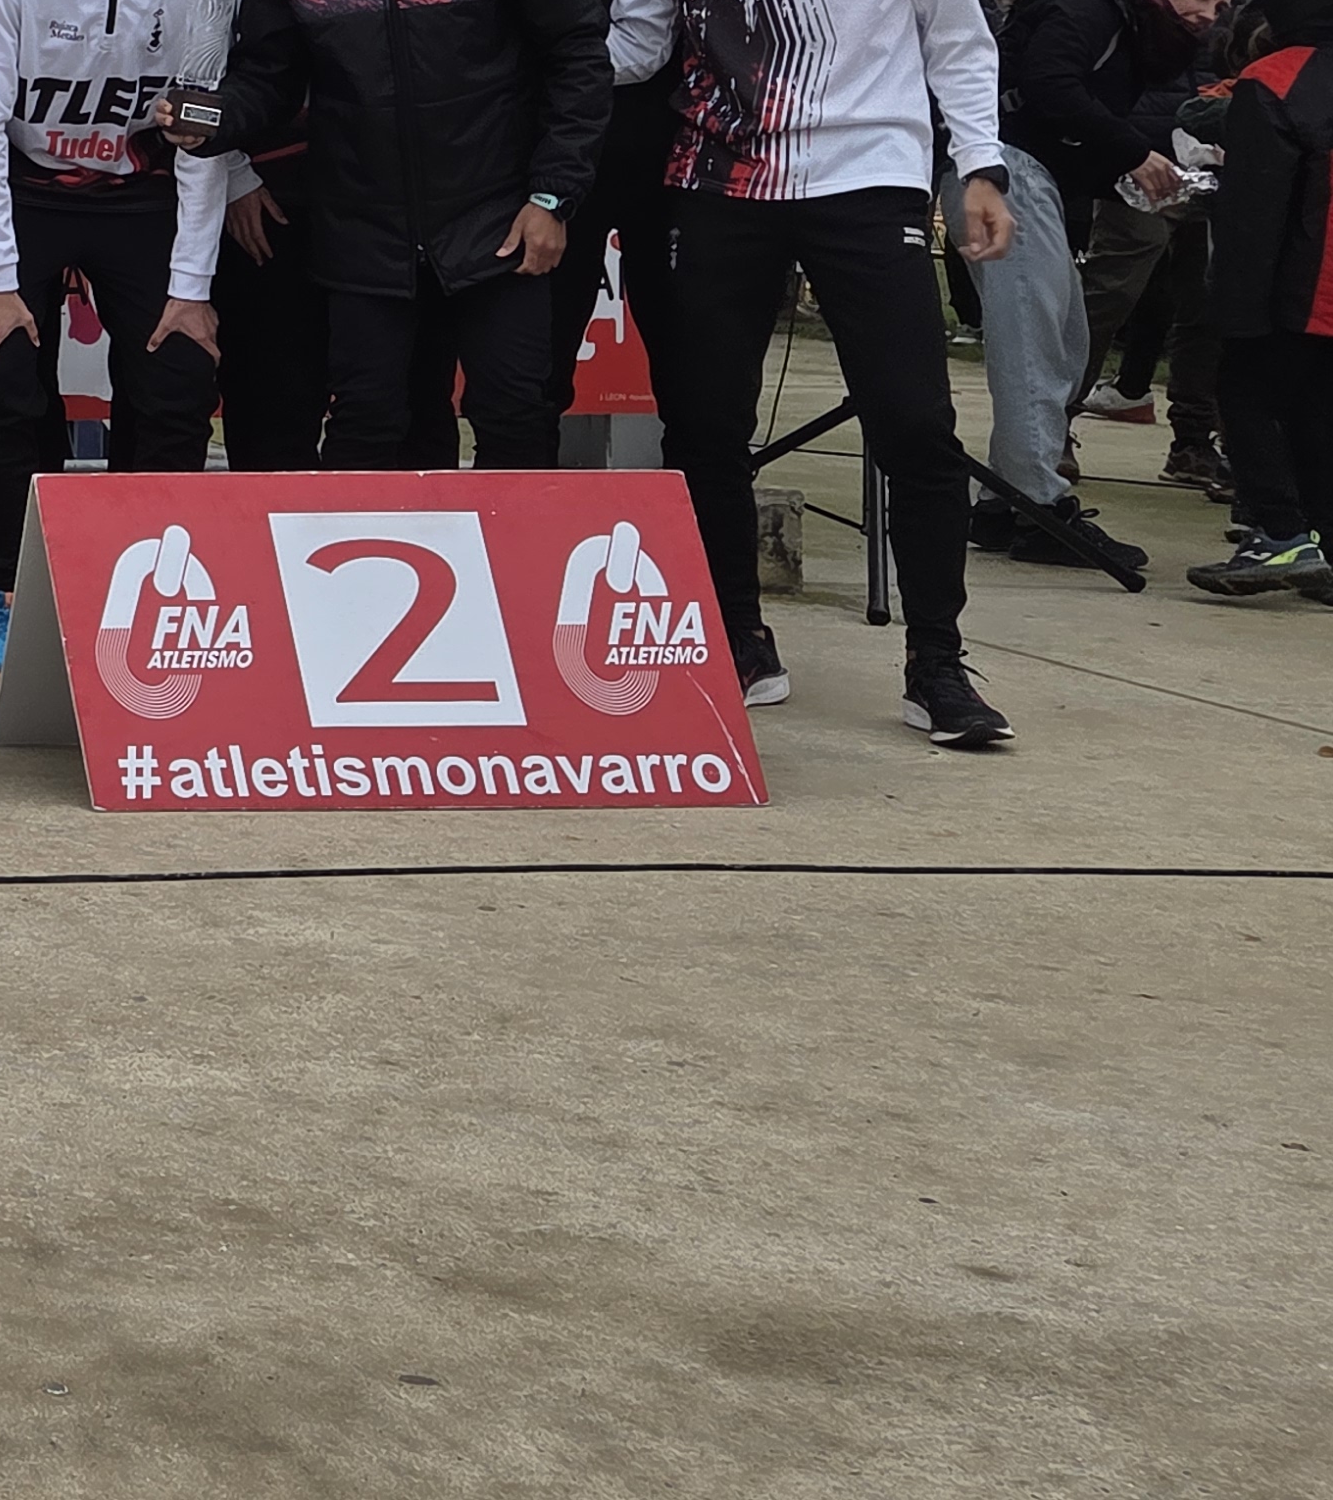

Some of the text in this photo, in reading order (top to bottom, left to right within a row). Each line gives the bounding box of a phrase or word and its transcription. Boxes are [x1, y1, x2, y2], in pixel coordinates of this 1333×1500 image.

[151, 605, 252, 650] FNA
[305, 538, 501, 704] 2
[607, 601, 707, 645] FNA
[146, 647, 254, 671] ATLETISMO
[604, 643, 708, 667] ATLETISMO
[118, 744, 733, 800] #atletismonavarro
